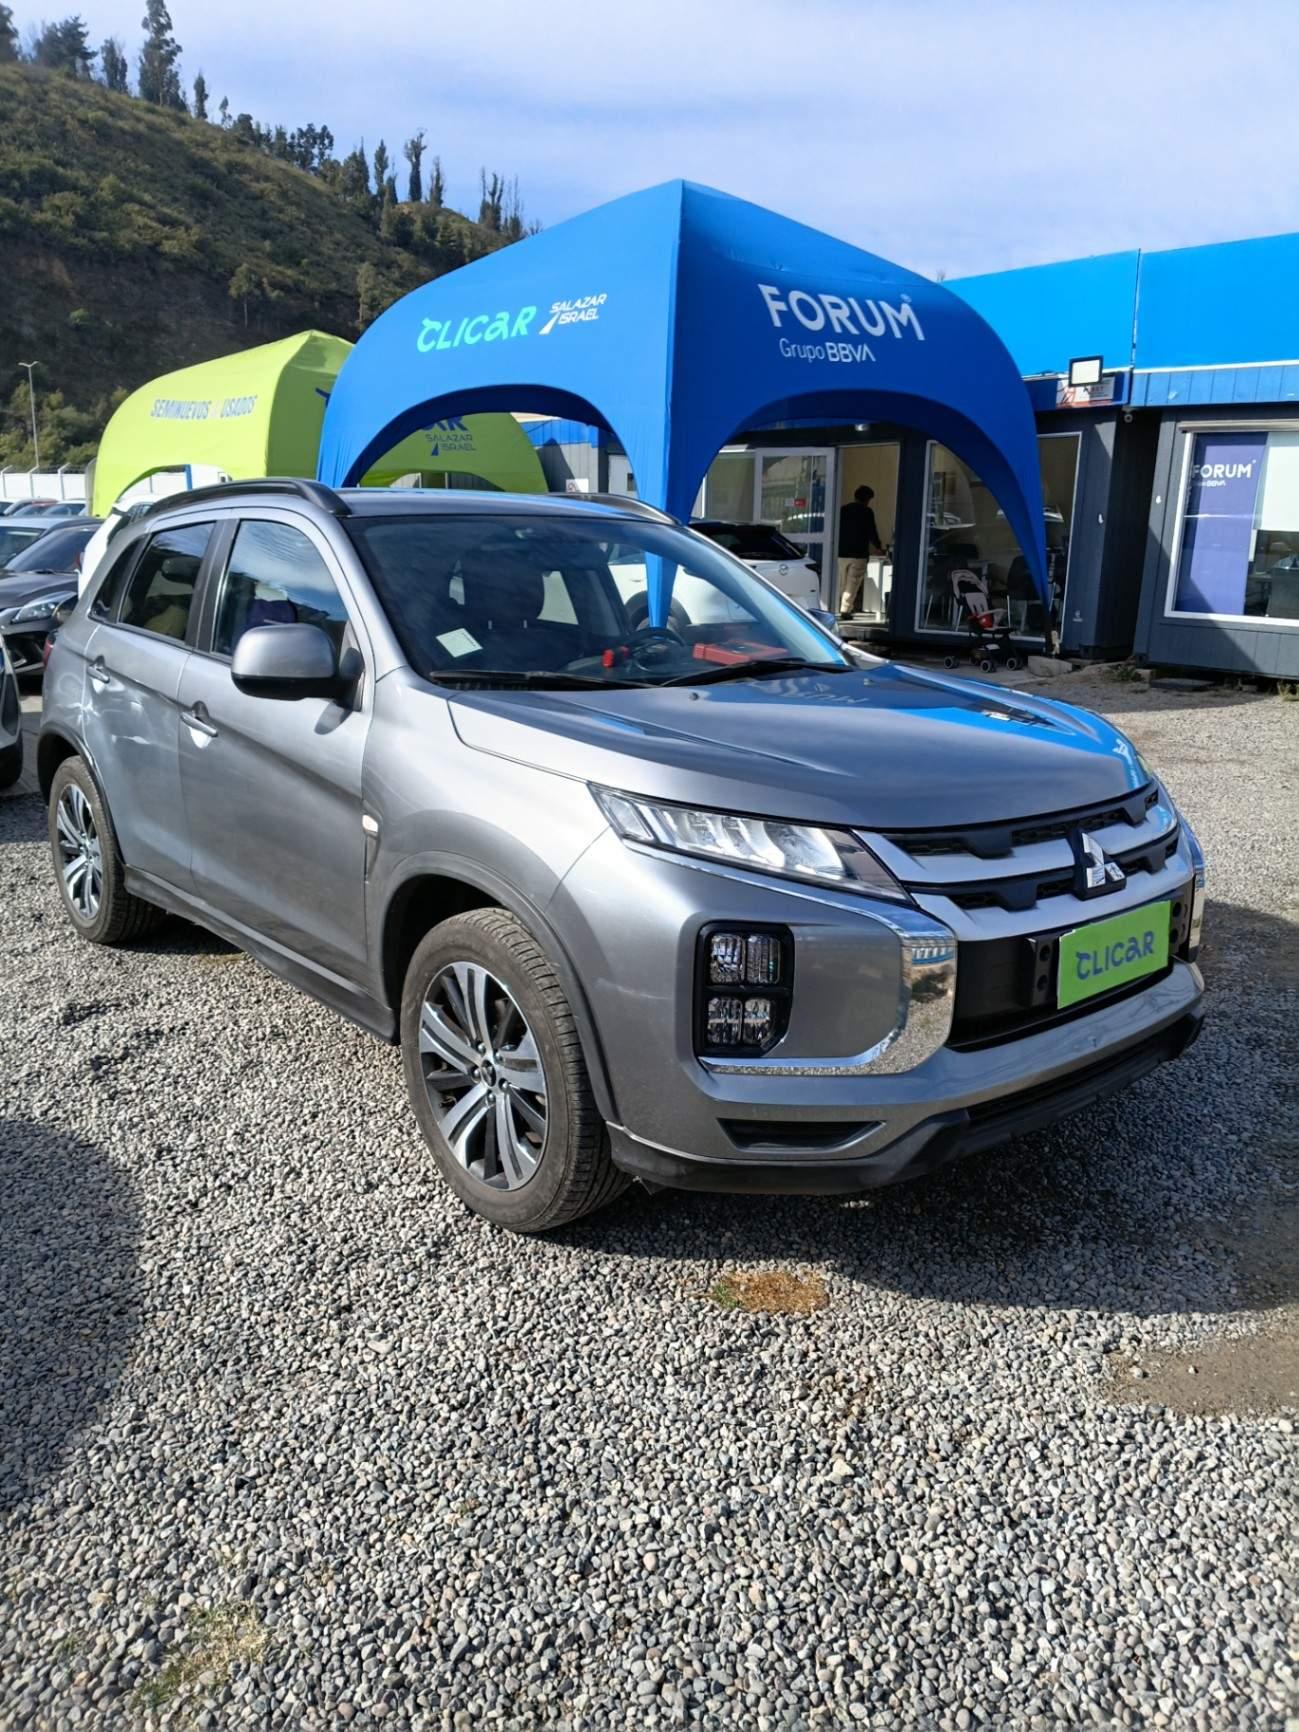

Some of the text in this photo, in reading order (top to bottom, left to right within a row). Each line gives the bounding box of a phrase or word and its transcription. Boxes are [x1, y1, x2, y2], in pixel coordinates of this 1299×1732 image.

[550, 293, 608, 313] SALAZAR
[757, 283, 925, 341] FORUM
[545, 308, 600, 331] ISRAEL
[778, 337, 877, 363] Grupo BBVA
[150, 398, 212, 420] SEMINUEVOS
[219, 394, 258, 418] USADOS
[425, 433, 474, 442] SALAZAR
[1192, 463, 1252, 479] FORUM
